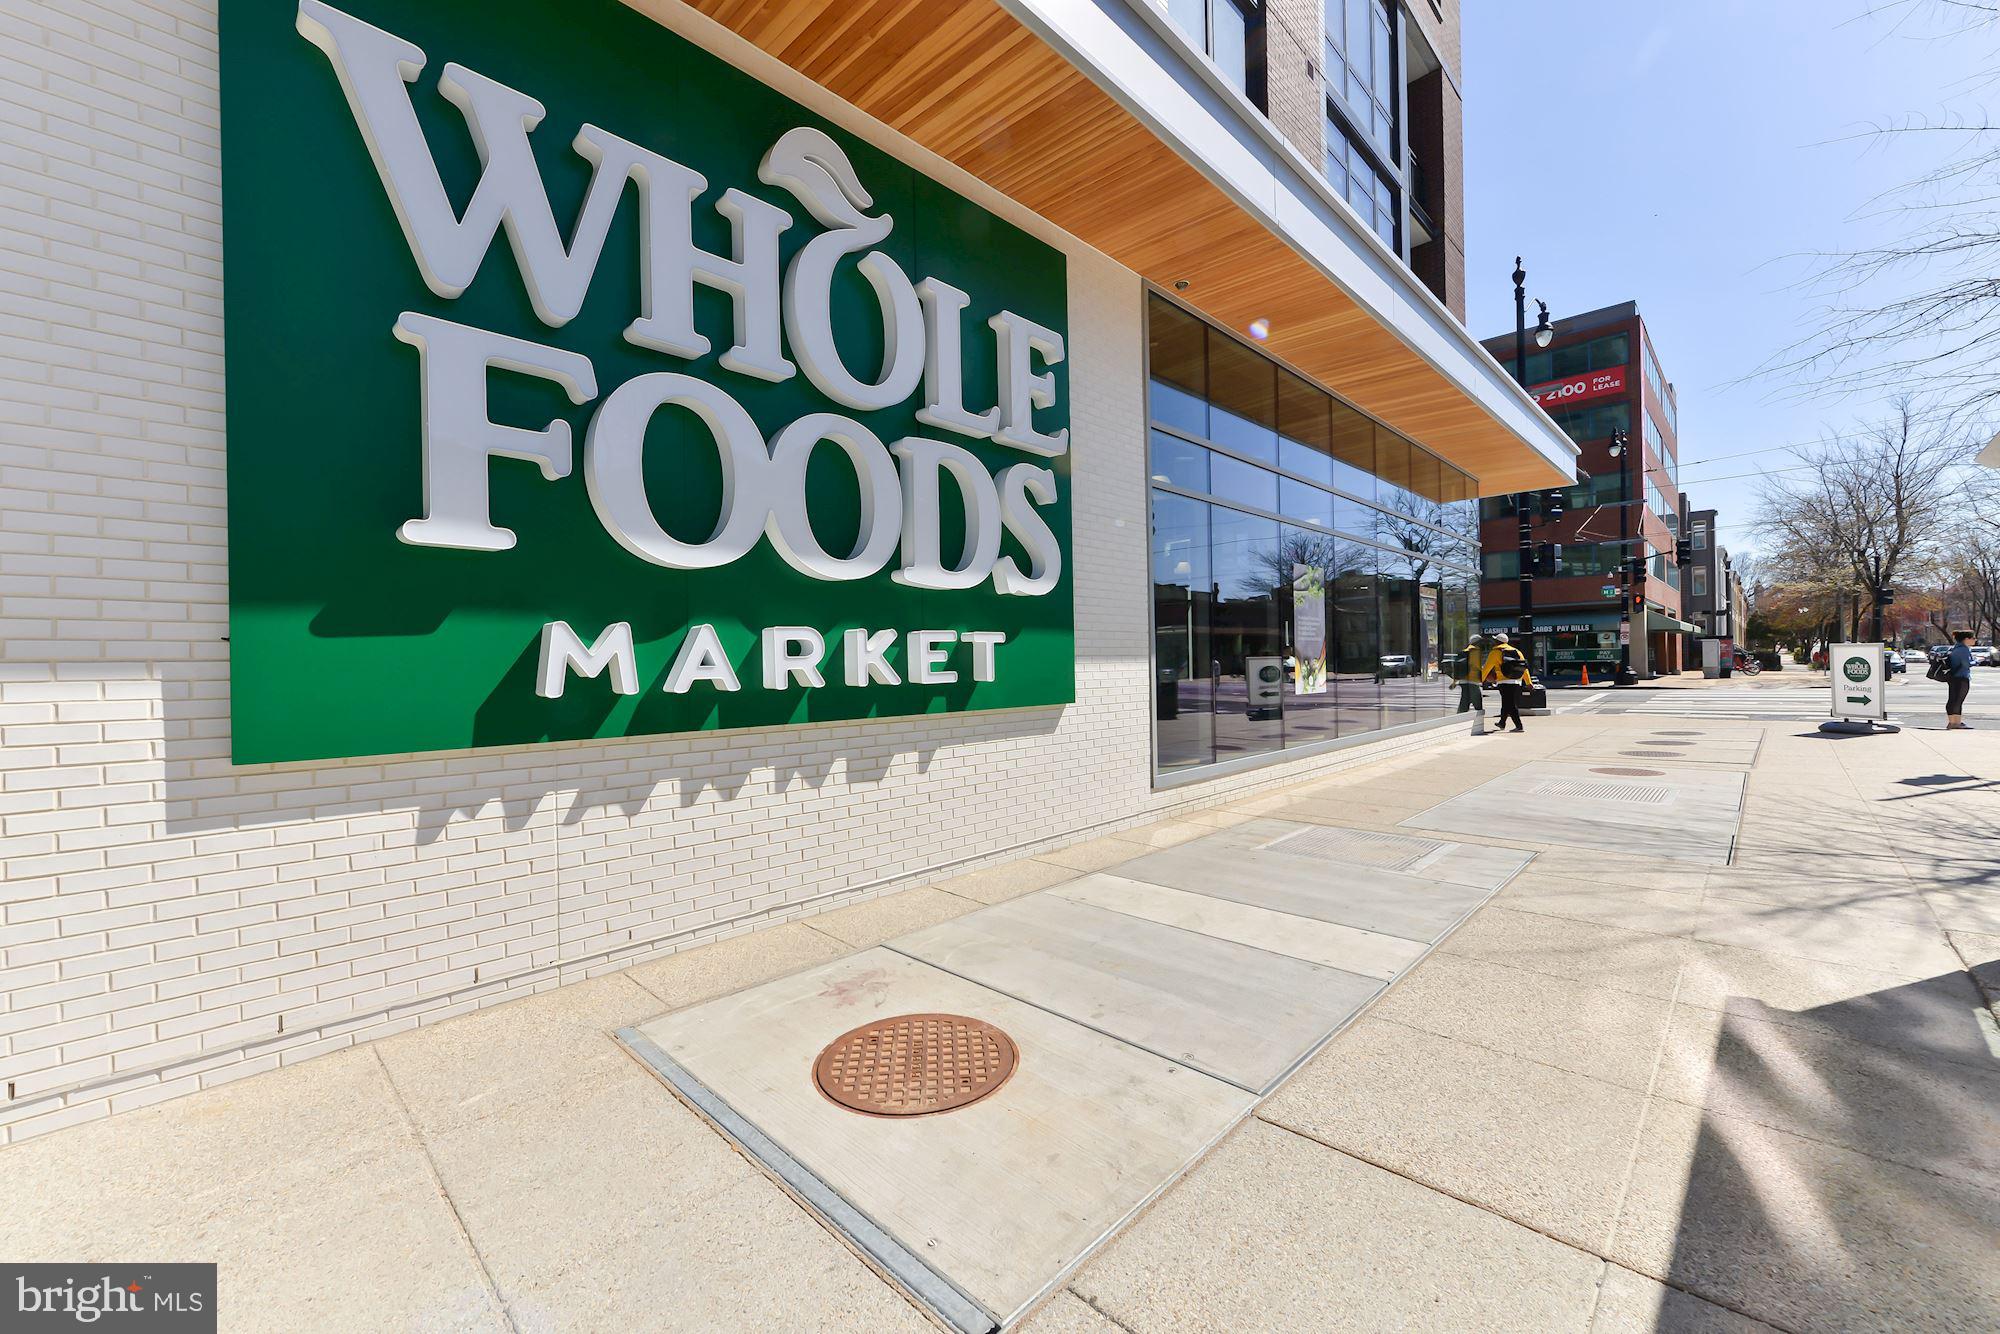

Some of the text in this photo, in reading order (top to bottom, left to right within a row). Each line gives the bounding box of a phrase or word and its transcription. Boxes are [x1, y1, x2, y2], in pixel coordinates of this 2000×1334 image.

[295, 0, 1068, 457] WHOLE
[1592, 375, 1611, 384] FOR
[1593, 380, 1621, 391] LEASE
[392, 311, 1061, 596] FOODS
[1533, 625, 1553, 633] ARDS
[1570, 624, 1590, 632] BILLS
[535, 620, 1006, 699] MARKET
[1845, 662, 1870, 670] WHOLE
[1843, 684, 1872, 694] Parking
